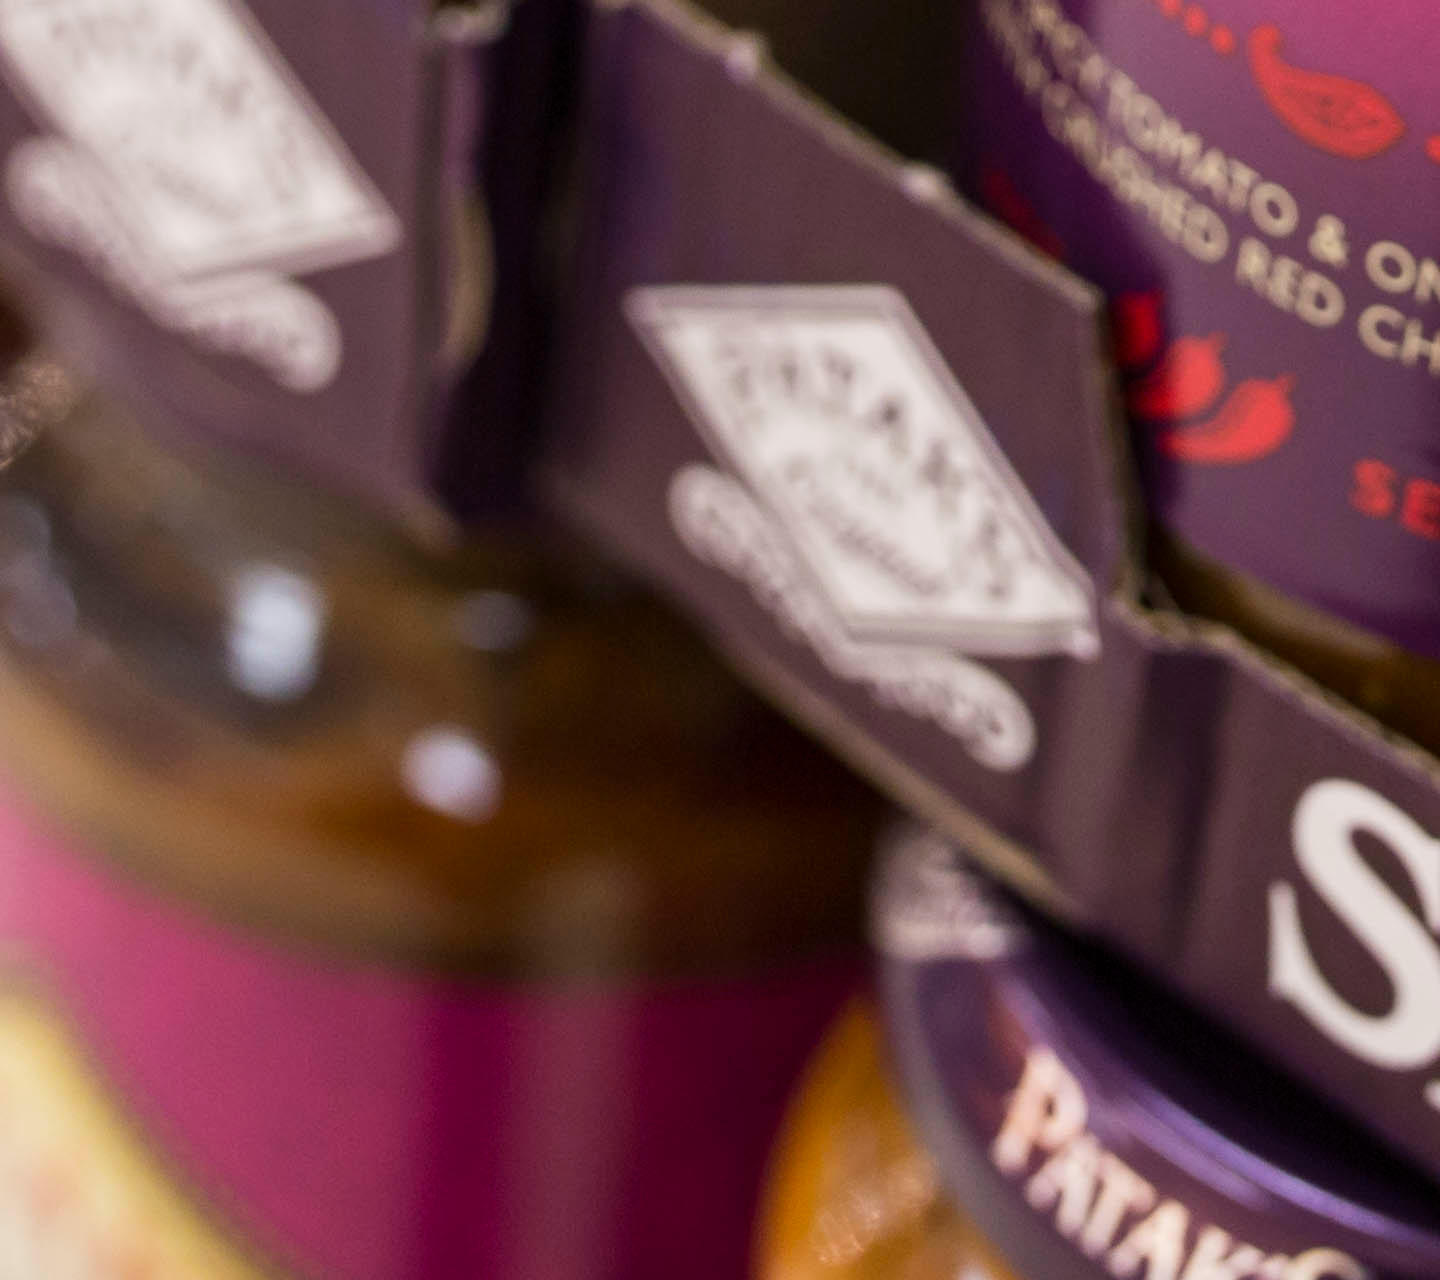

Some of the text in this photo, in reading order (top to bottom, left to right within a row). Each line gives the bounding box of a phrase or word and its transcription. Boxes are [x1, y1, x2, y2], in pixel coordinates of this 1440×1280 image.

[1106, 66, 1299, 238] TOMATO
[1307, 213, 1350, 268] &
[1235, 238, 1346, 328] RED
